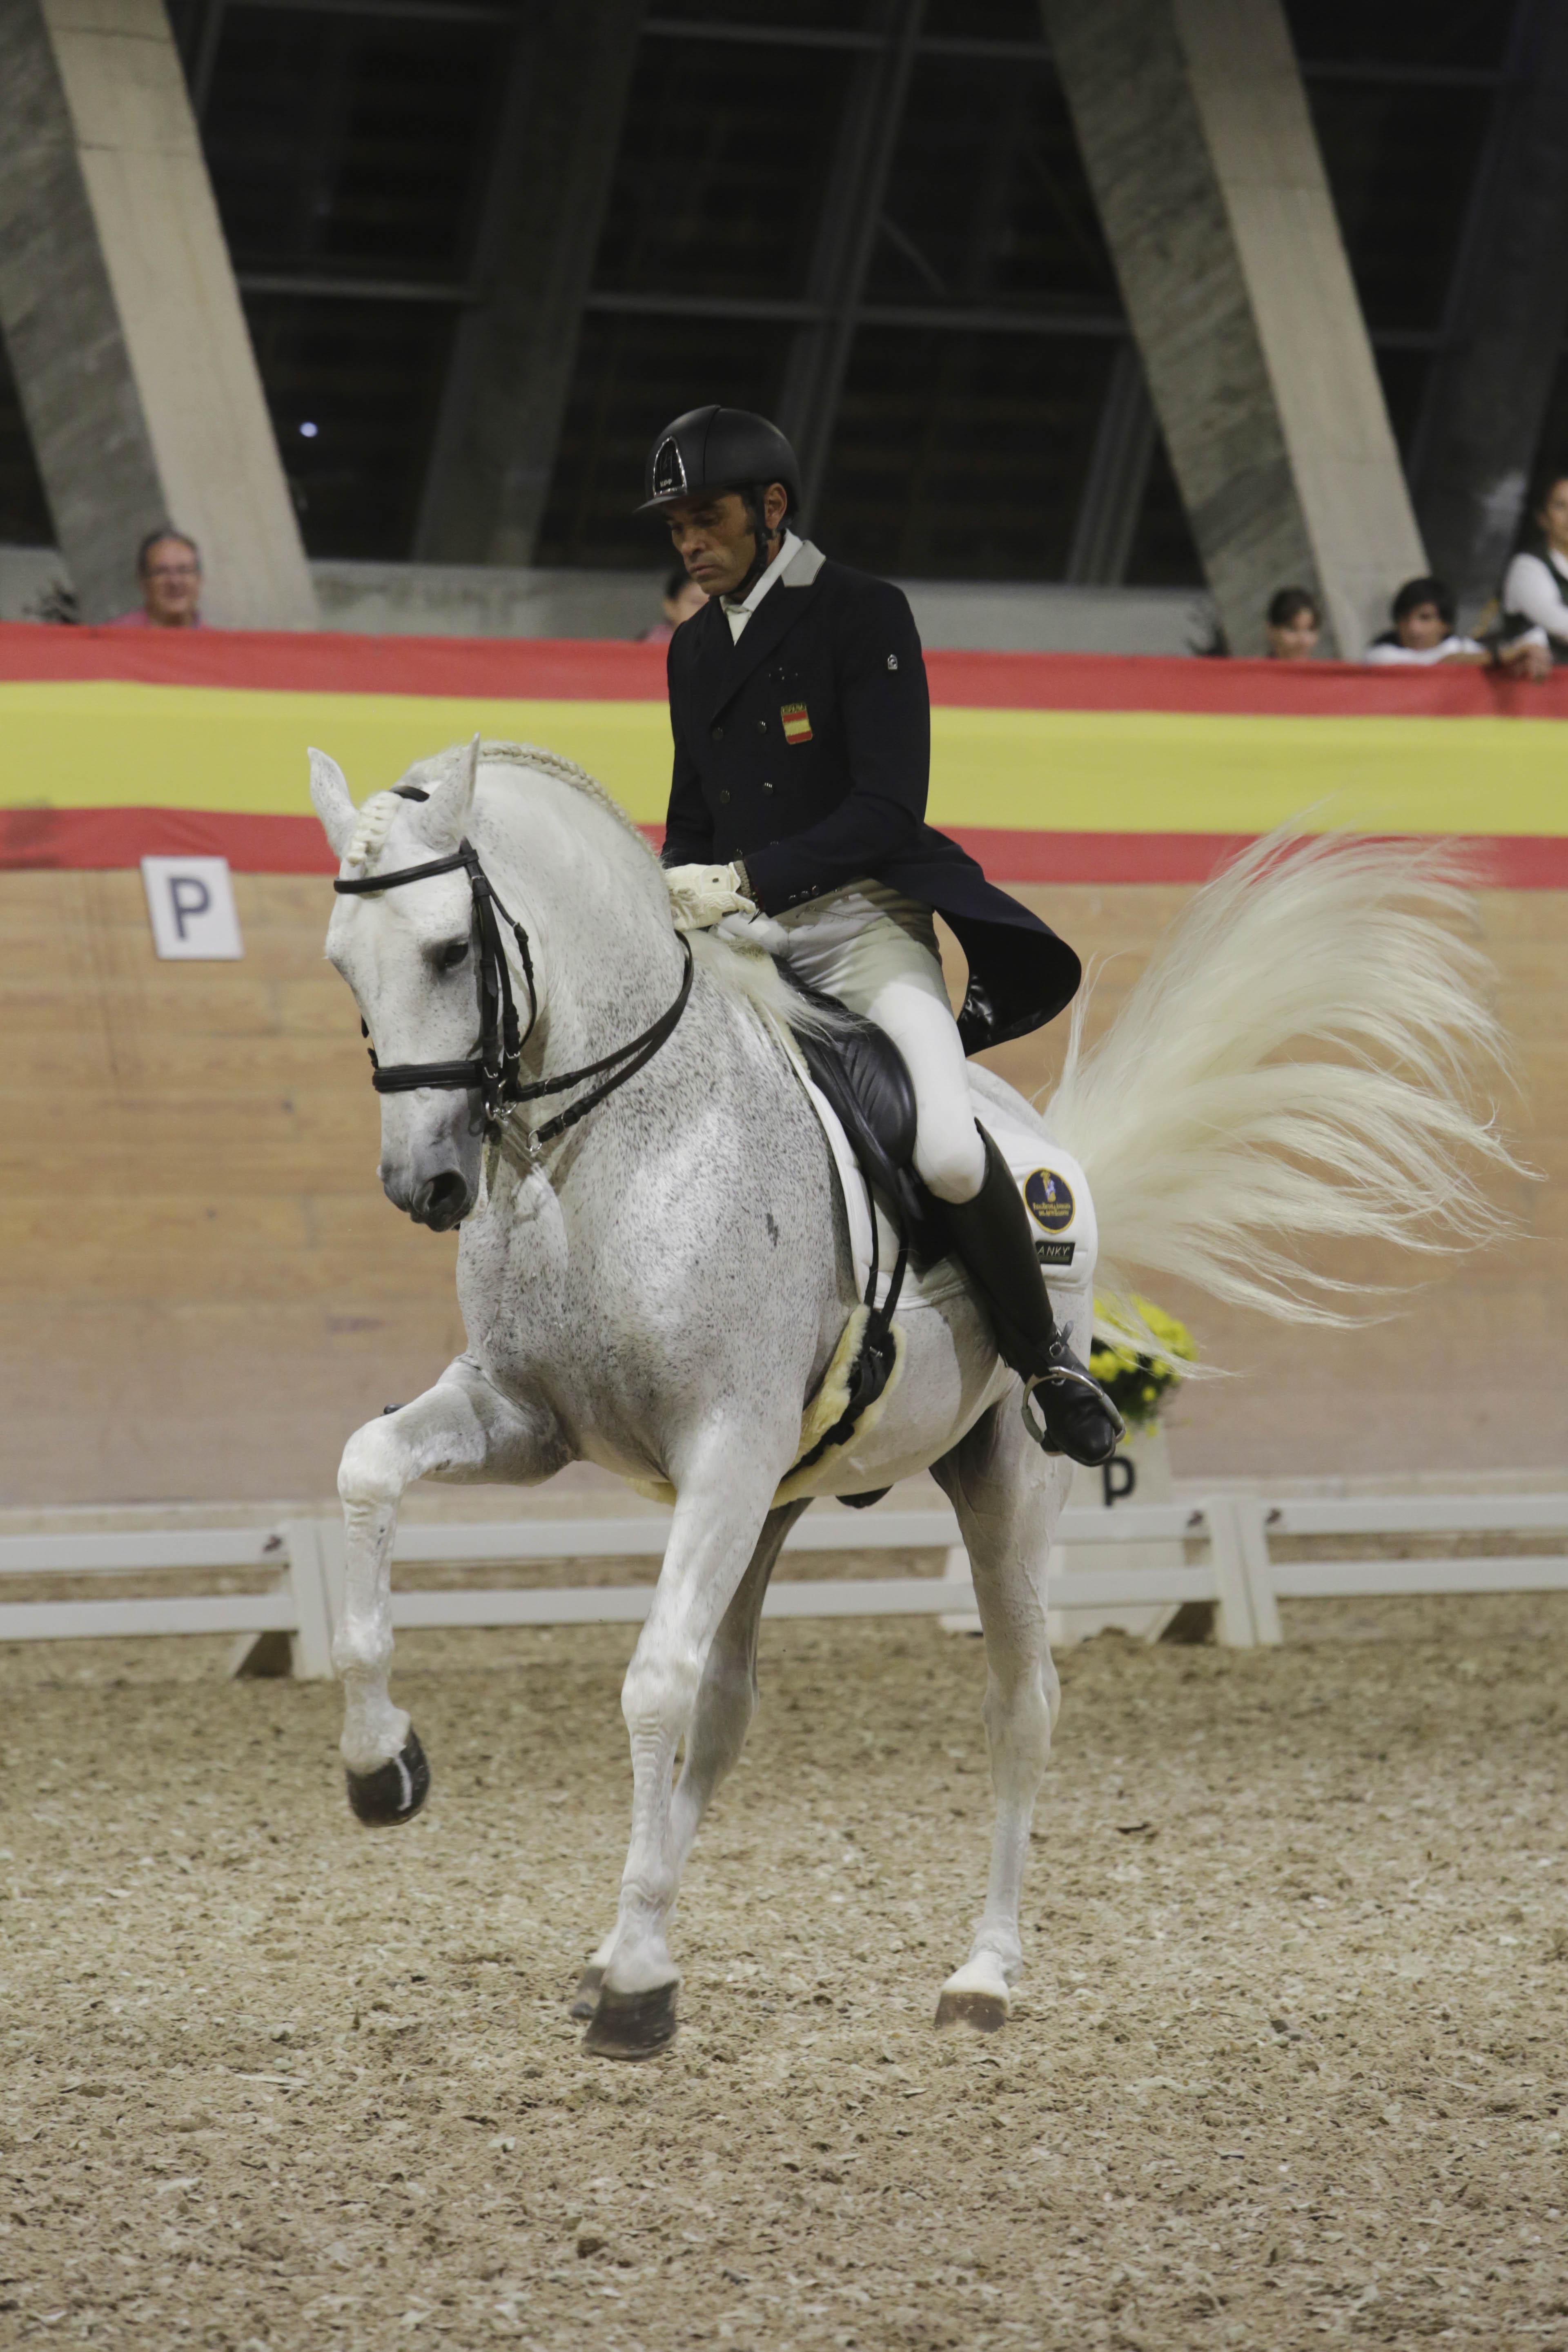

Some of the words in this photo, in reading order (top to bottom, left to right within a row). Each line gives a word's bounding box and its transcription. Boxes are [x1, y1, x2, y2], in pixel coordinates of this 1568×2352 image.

[168, 877, 211, 940] P
[1038, 1246, 1069, 1256] ANKY
[1103, 1456, 1135, 1506] P
